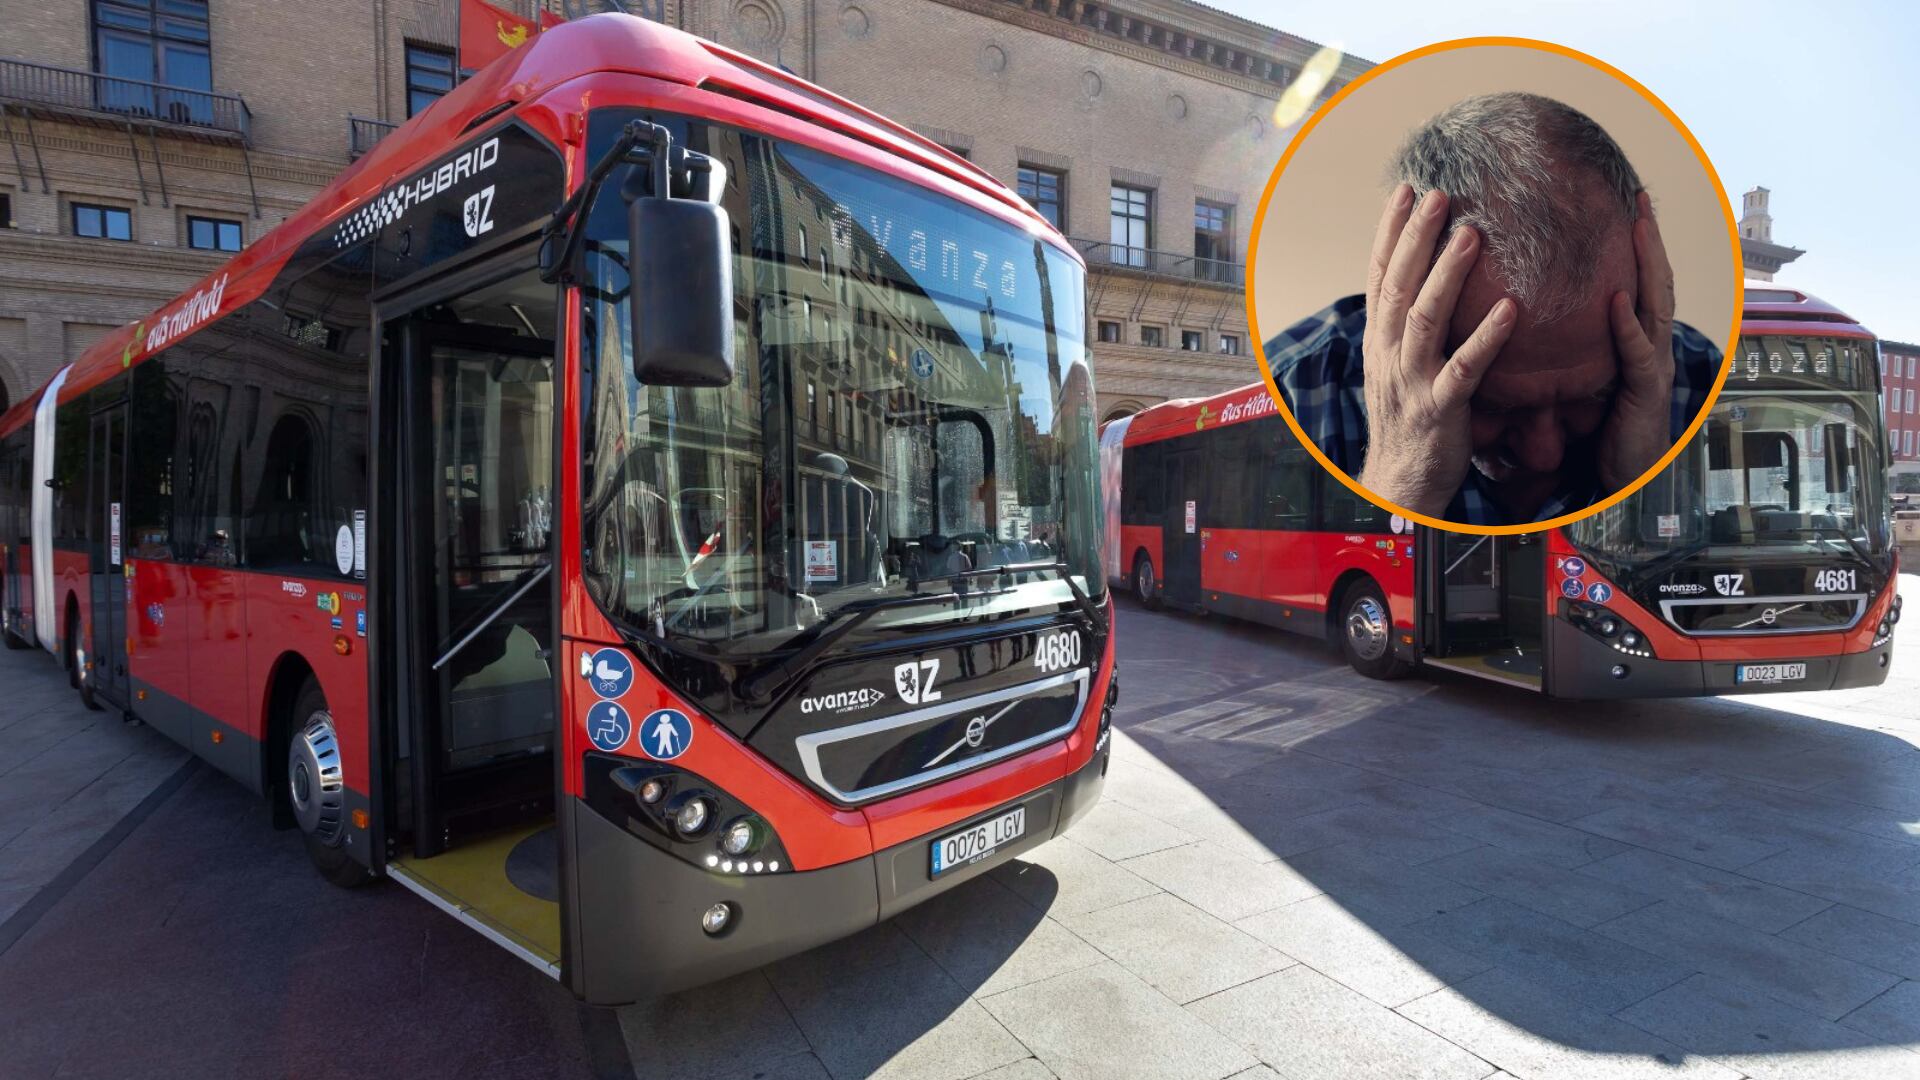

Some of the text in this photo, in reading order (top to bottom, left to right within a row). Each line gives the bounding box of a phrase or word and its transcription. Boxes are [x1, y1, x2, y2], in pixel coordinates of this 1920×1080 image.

[404, 138, 499, 209] HYBRID
[832, 203, 1016, 298] avanza
[1221, 403, 1244, 423] Bus
[1659, 584, 1697, 592] avanza
[1814, 569, 1856, 592] 4681
[1034, 630, 1081, 673] 4680
[1746, 665, 1803, 680] 0023 LGV
[801, 688, 869, 713] avanza
[947, 827, 986, 864] 0076
[995, 812, 1022, 843] LGV
